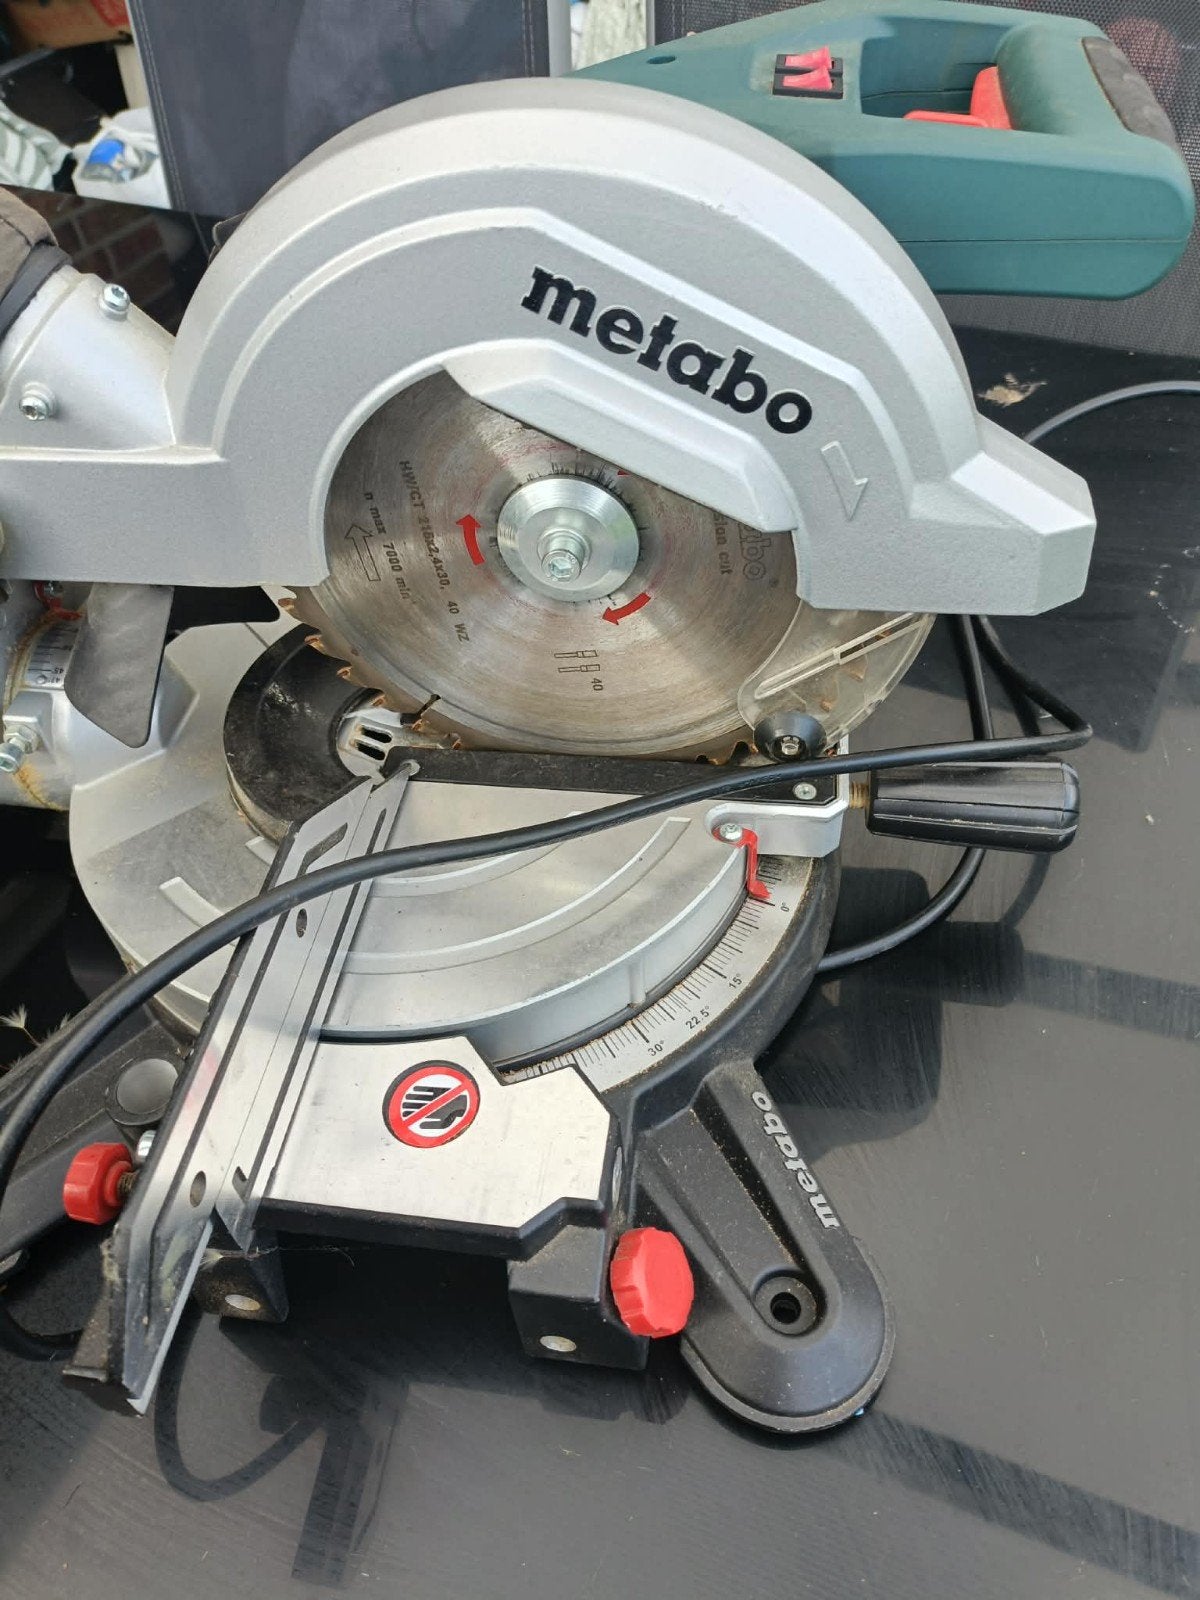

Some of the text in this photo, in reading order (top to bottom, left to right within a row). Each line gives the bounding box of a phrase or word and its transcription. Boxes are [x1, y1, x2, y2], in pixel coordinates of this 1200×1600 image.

[520, 266, 812, 434] metabo
[383, 542, 402, 573] 7000
[447, 601, 460, 614] 40
[454, 623, 470, 642] WZ
[590, 678, 603, 691] 40
[728, 973, 743, 989] 15°
[685, 1005, 710, 1029] 22.5°
[647, 1039, 666, 1057] 30°
[752, 1091, 841, 1229] metabo
